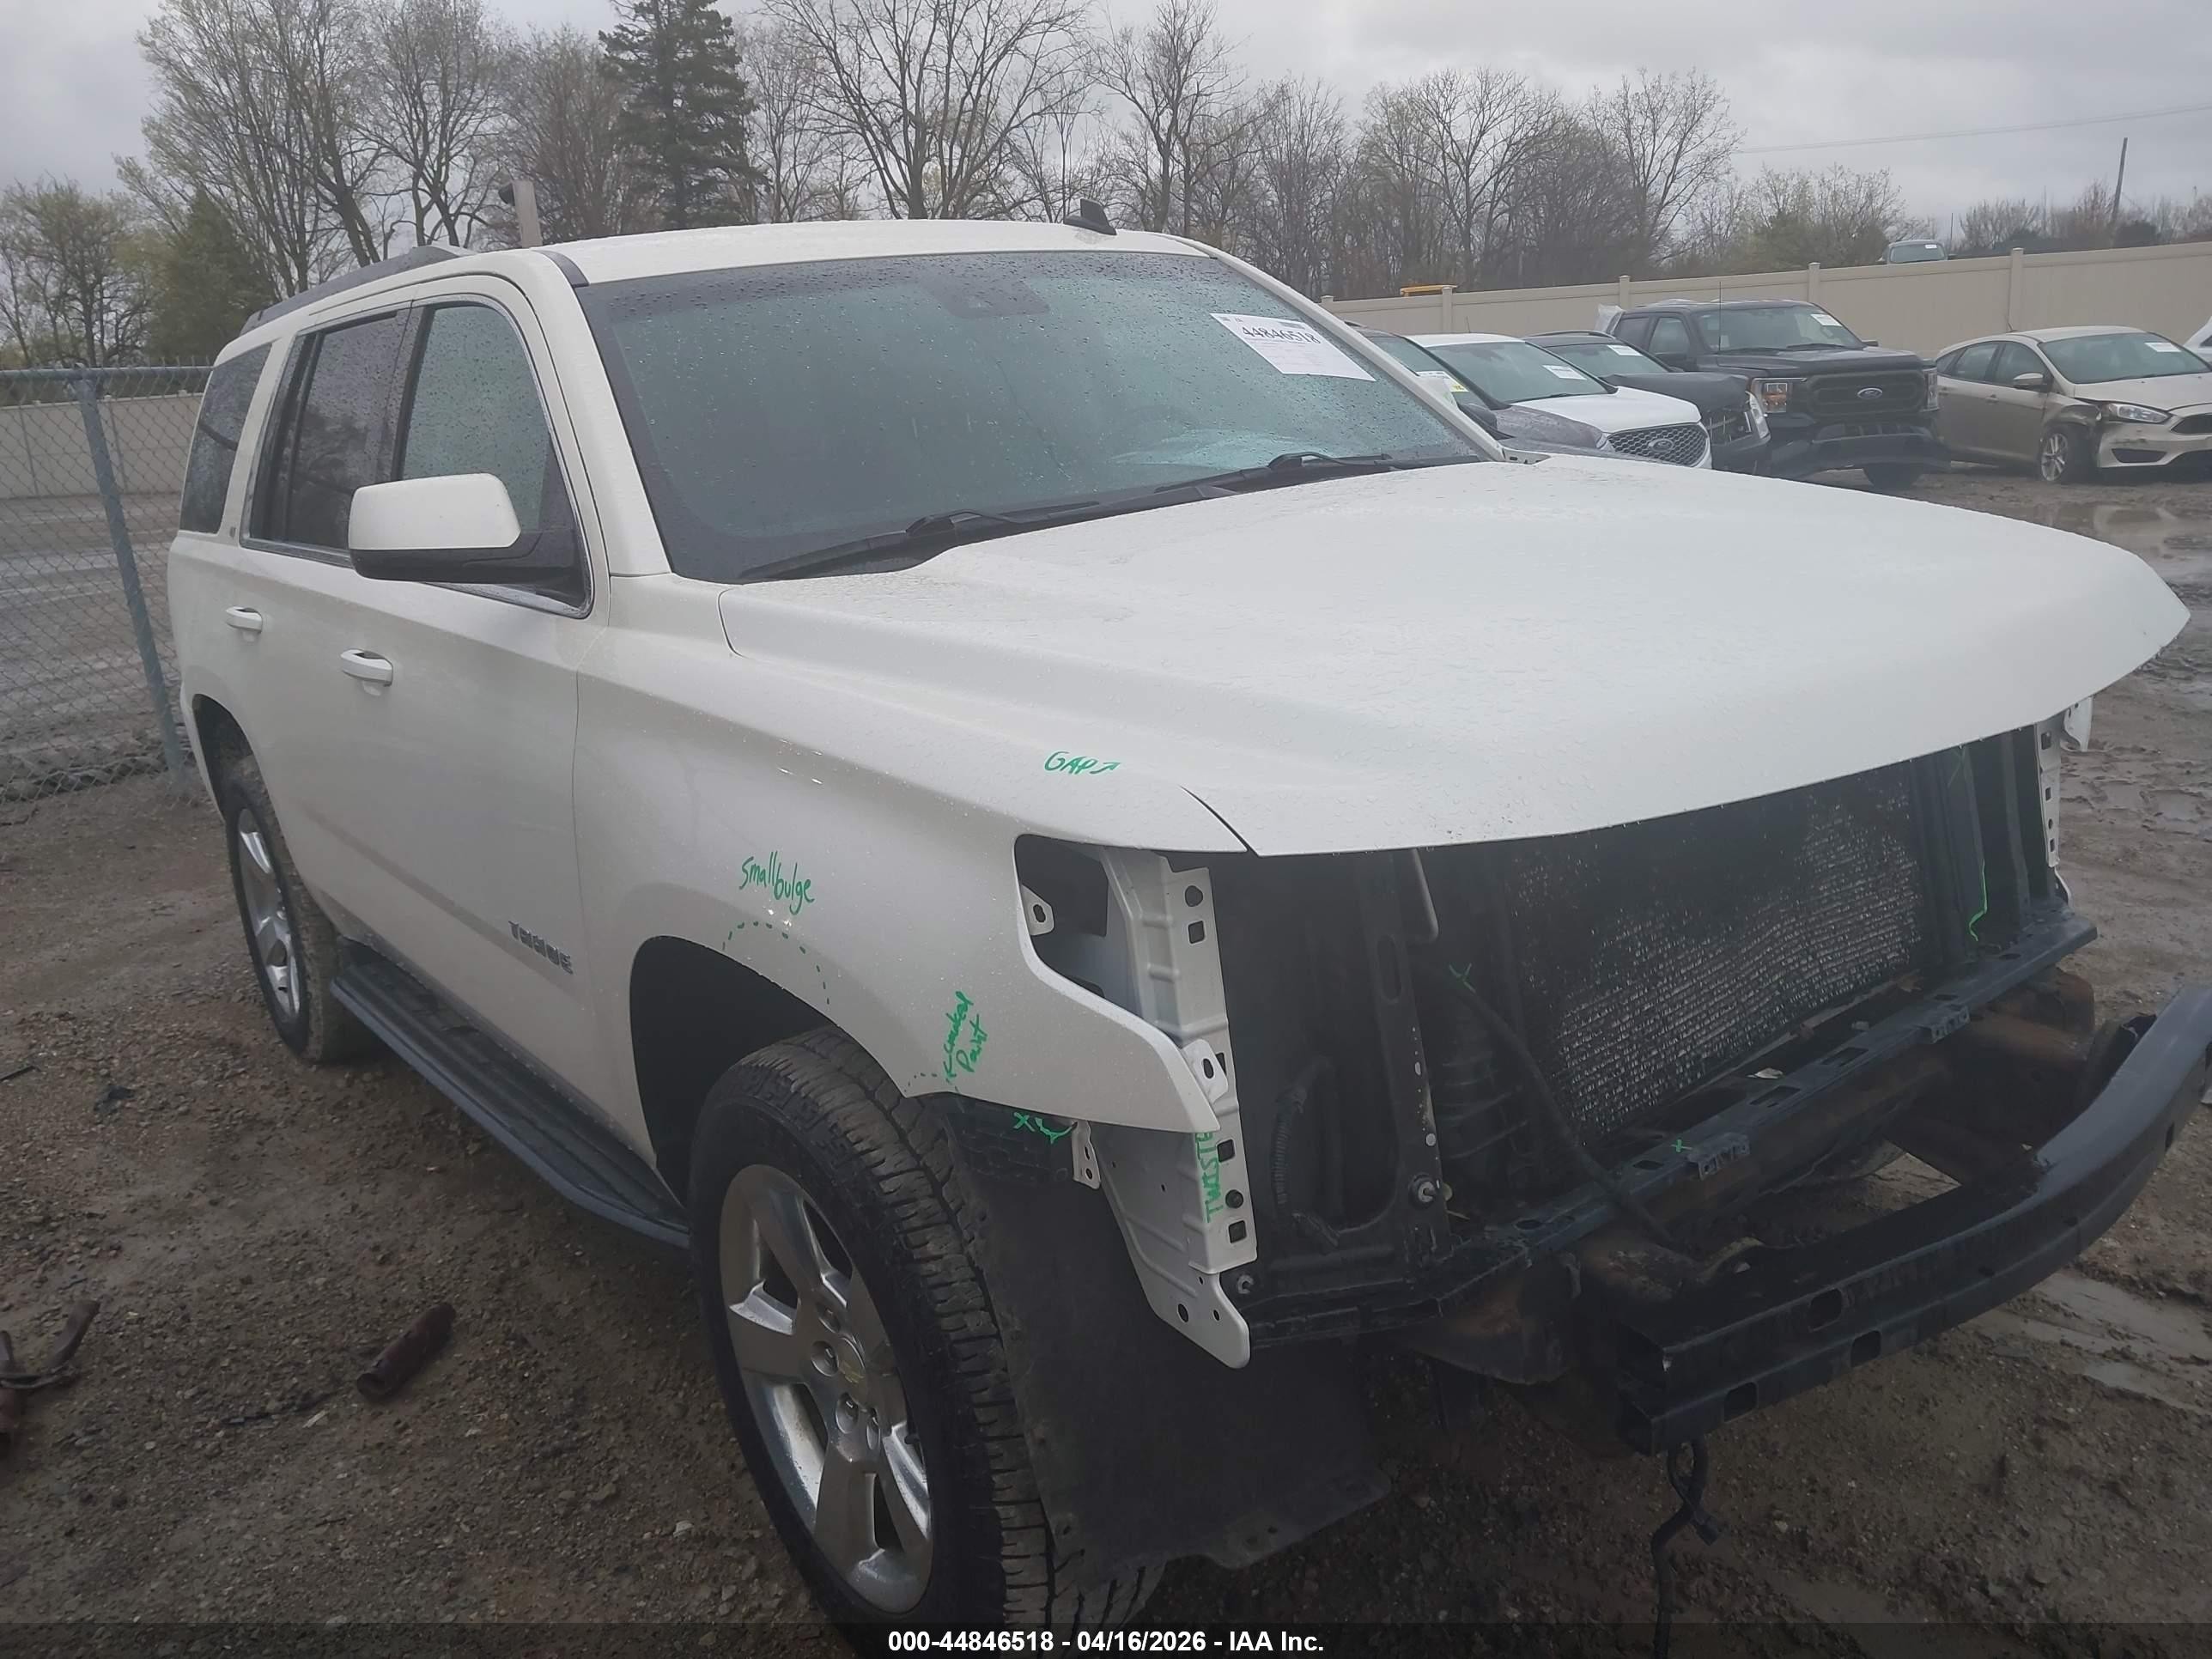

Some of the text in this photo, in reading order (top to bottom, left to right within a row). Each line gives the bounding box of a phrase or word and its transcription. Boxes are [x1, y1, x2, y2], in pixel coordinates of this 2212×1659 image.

[1242, 325, 1322, 344] 44846518
[1043, 750, 1098, 775] GAP
[774, 861, 816, 916] bulge
[507, 920, 574, 975] TAHOE
